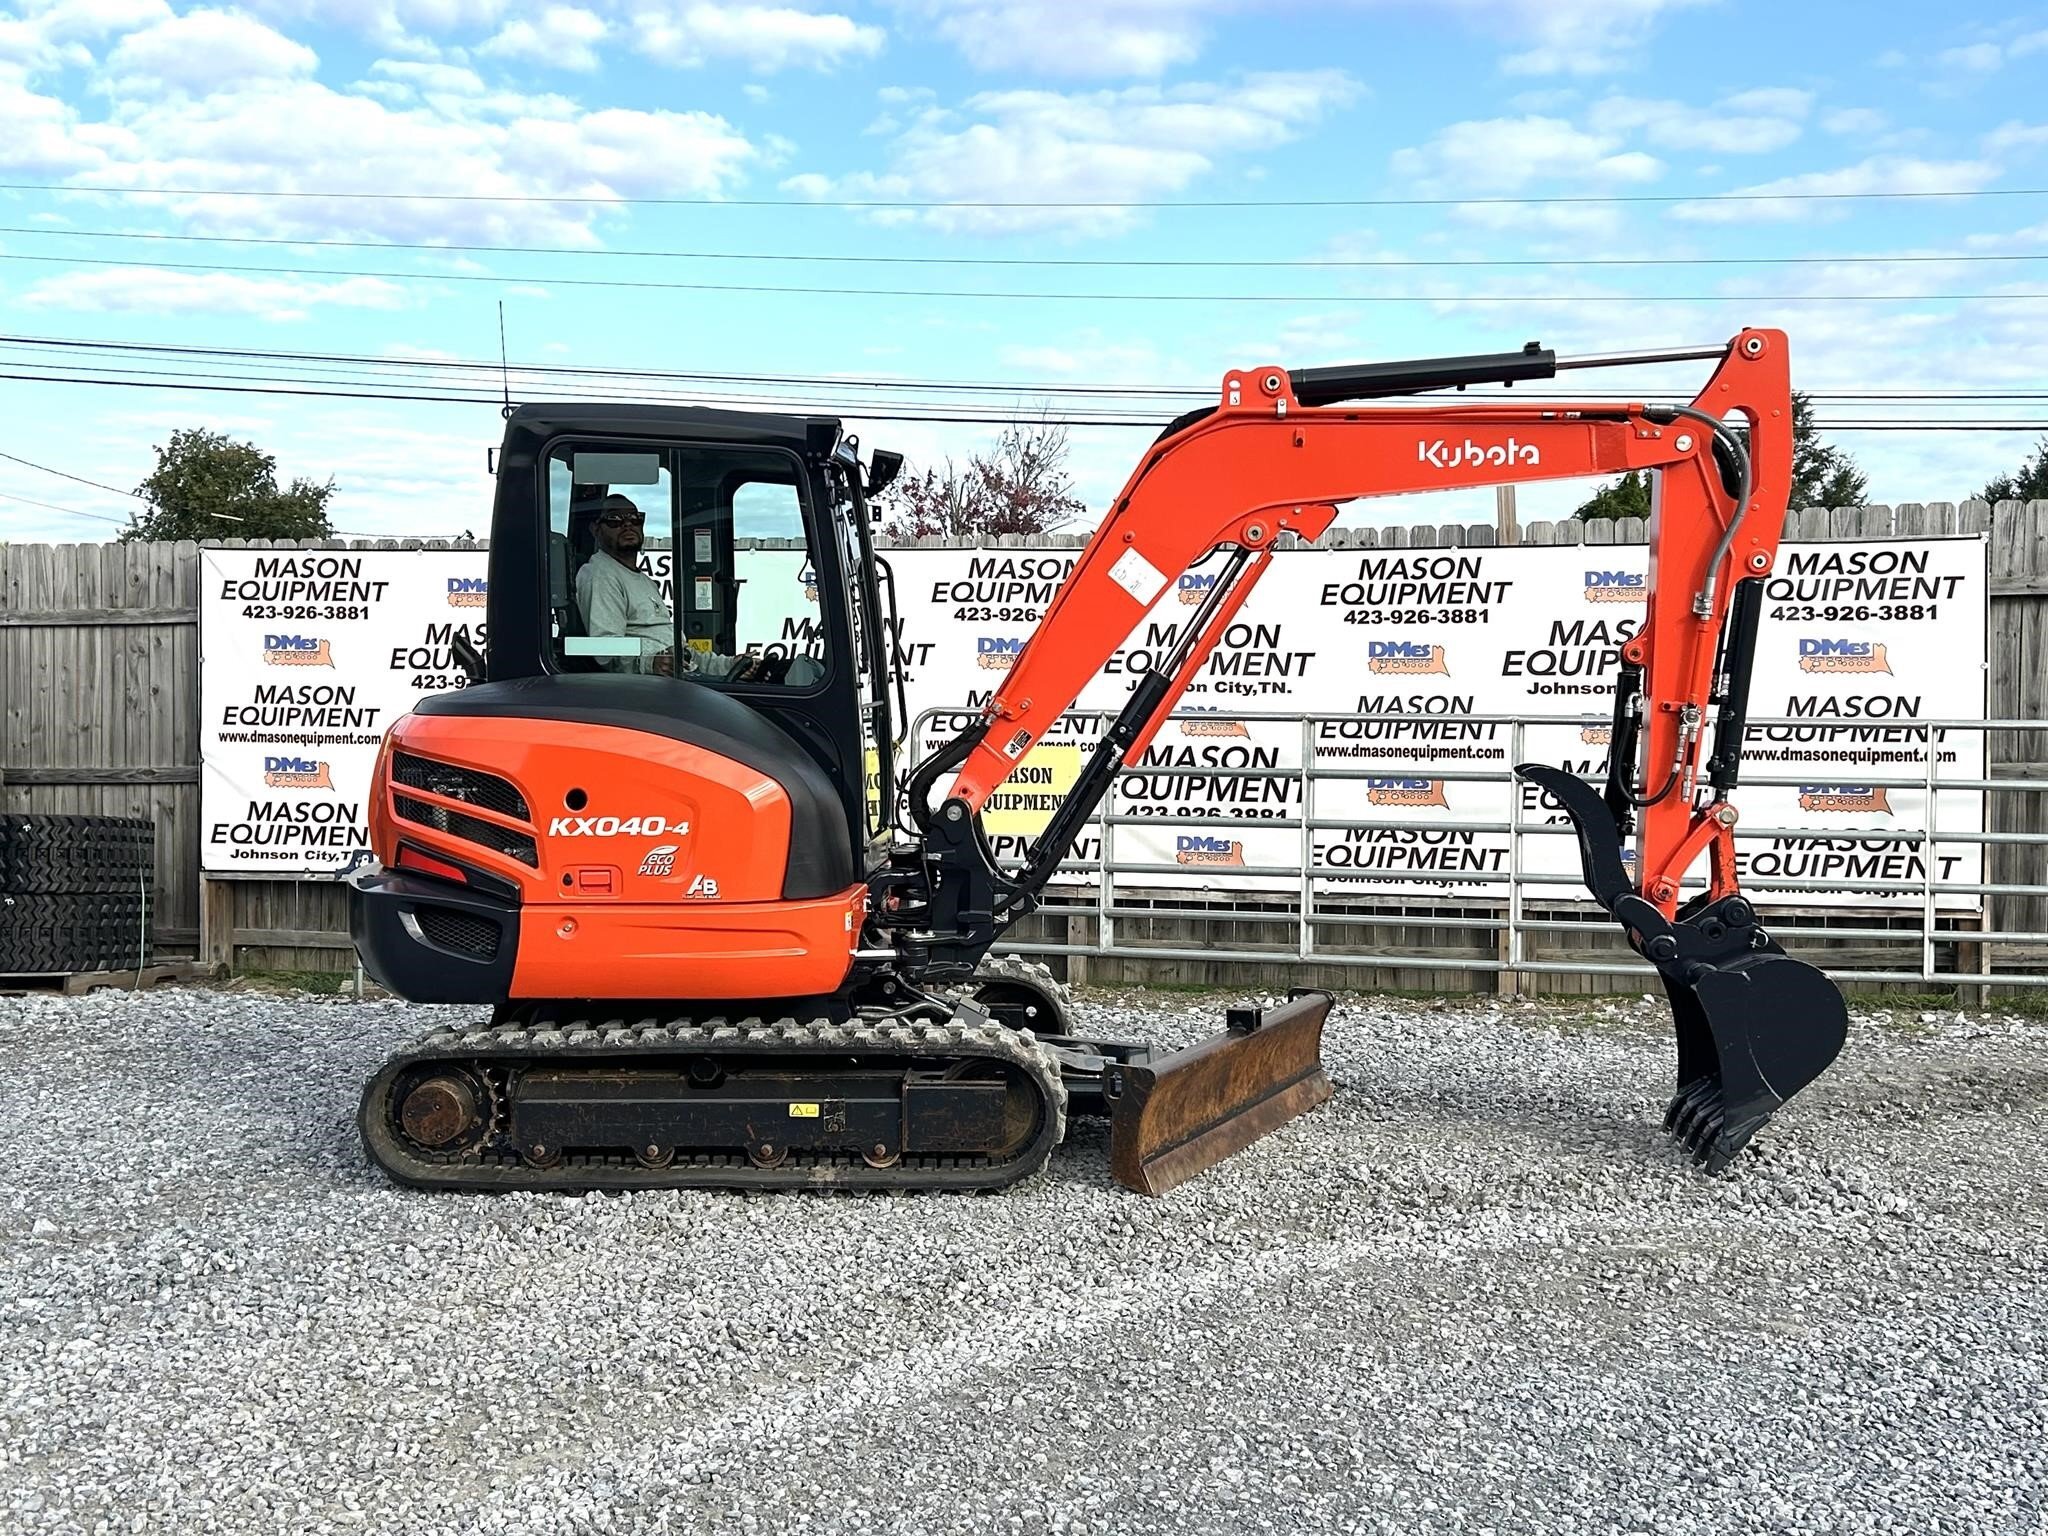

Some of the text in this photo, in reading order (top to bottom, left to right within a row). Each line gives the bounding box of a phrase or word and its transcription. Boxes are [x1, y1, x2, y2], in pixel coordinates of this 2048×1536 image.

[1418, 437, 1540, 468] Kubota
[254, 558, 362, 579] MASON
[1358, 557, 1482, 580] MASON
[1787, 550, 1929, 576] MASON
[220, 580, 389, 602] EQUIPMENT
[931, 582, 1064, 603] EQUIPM
[1320, 581, 1513, 606] EQUIPMENT
[1766, 576, 1965, 602] QUIPMENT
[242, 605, 369, 620] 423-926-3881
[954, 607, 1047, 622] 423-926-
[1344, 609, 1489, 625] 423-926-3881
[1770, 605, 1938, 621] 423-926-3881
[424, 623, 487, 646] MAS
[1146, 623, 1281, 649] MON
[1548, 619, 1638, 646] MAS
[1103, 649, 1316, 677] EQMENT
[1501, 649, 1620, 677] EQUIP
[253, 685, 356, 706] MASON
[1356, 695, 1474, 714] MASON
[222, 706, 381, 728] EQUIPMENT
[1786, 696, 1921, 718] MASON
[218, 730, 382, 748] www.dmasonequipment.com
[1142, 745, 1279, 768] MASON
[1315, 744, 1505, 762] www.dmasonequipment.com
[1004, 767, 1053, 785] ASON
[247, 800, 358, 823] MASON
[982, 793, 1068, 814] QUIPMEN
[210, 823, 368, 847] EQUIPMEN
[549, 816, 690, 837] KX040-4
[230, 849, 350, 862] Johnson City,T
[638, 865, 673, 876] PLUS
